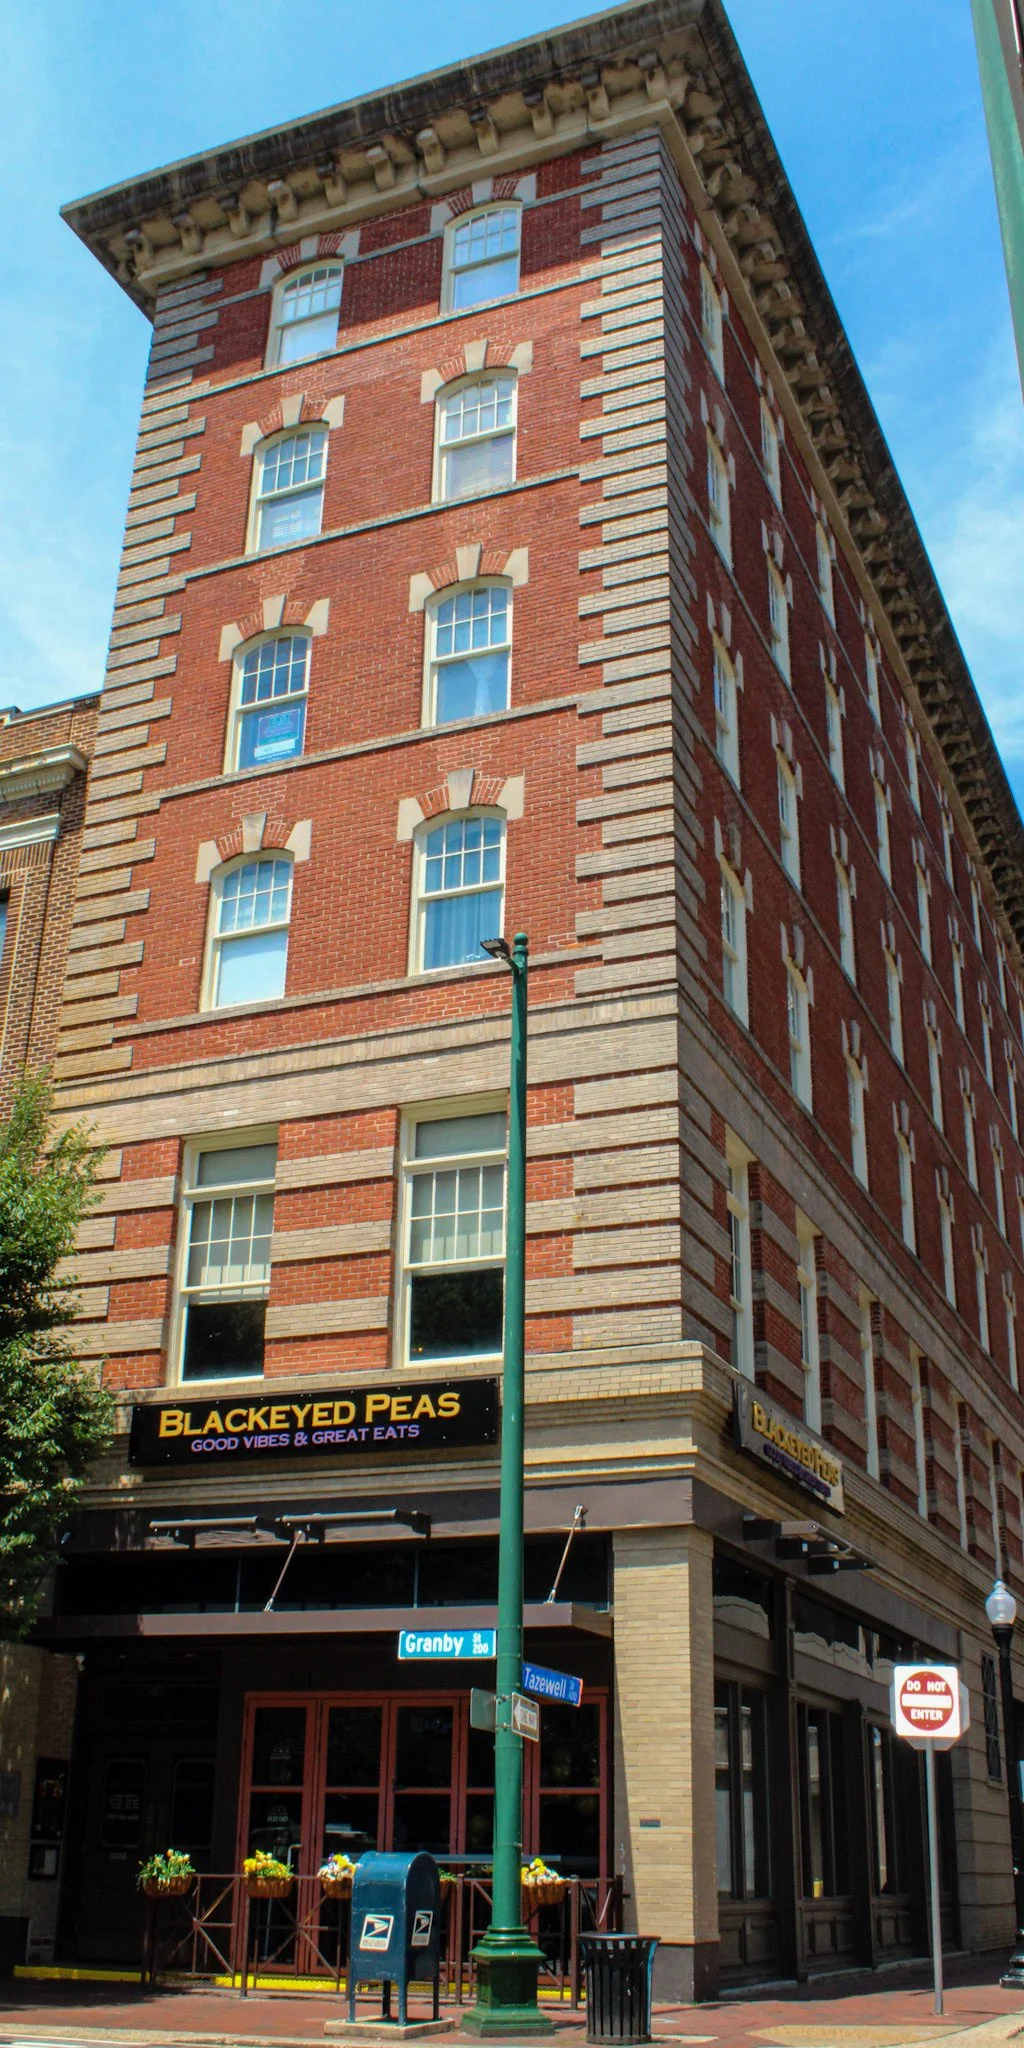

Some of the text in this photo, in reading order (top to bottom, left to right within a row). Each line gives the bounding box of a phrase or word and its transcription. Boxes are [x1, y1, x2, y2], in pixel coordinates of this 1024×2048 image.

[158, 1392, 461, 1438] BLACKEYED PEAS
[191, 1424, 420, 1453] GOOD VIBES & GREAT EATS
[405, 1632, 482, 1657] Granby St
[472, 1643, 489, 1655] 200
[524, 1667, 567, 1698] Tazewell
[906, 1680, 947, 1693] DO NOT
[910, 1708, 944, 1721] ENTER
